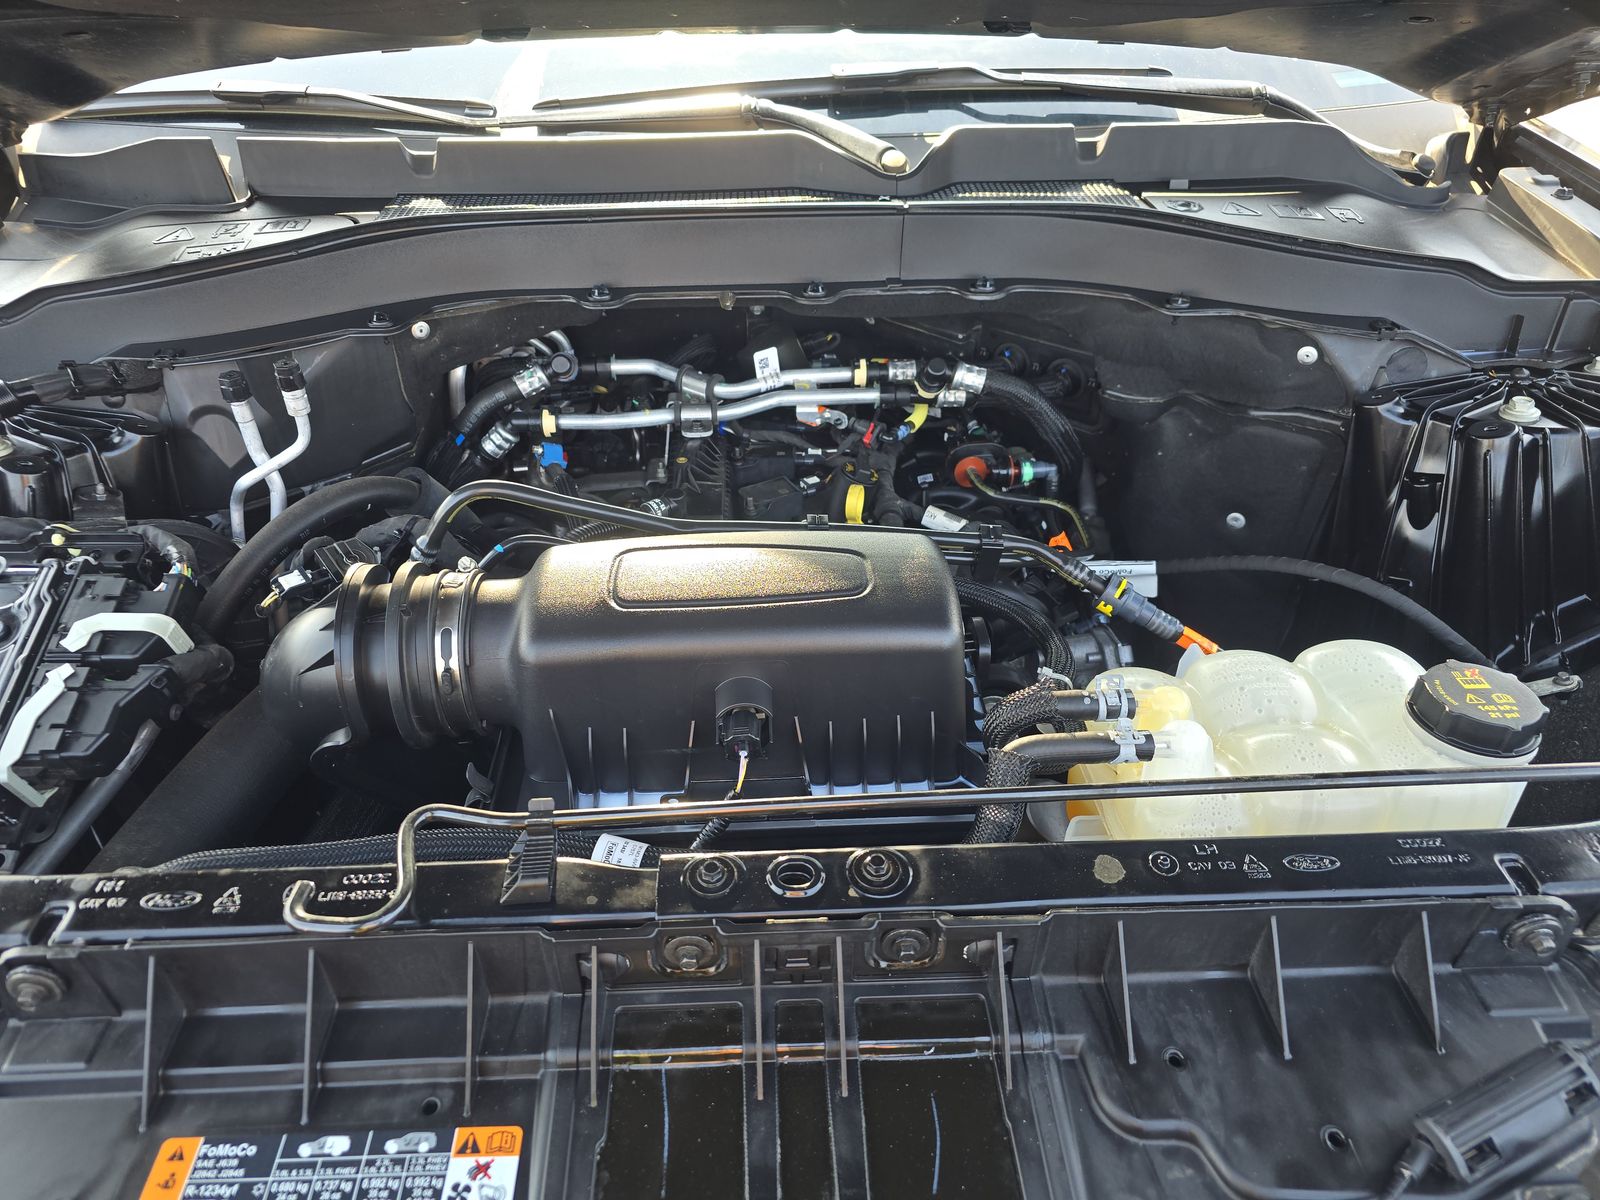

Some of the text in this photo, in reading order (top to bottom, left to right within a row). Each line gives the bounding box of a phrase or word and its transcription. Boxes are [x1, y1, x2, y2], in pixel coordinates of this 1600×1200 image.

[603, 842, 617, 865] FoMoC
[1193, 844, 1219, 855] LH
[198, 1143, 258, 1158] FoMoCo
[296, 1181, 310, 1195] kg
[339, 1179, 354, 1193] kg
[387, 1177, 401, 1191] kg
[430, 1176, 444, 1190] kg
[184, 1183, 240, 1199] R-1234yf
